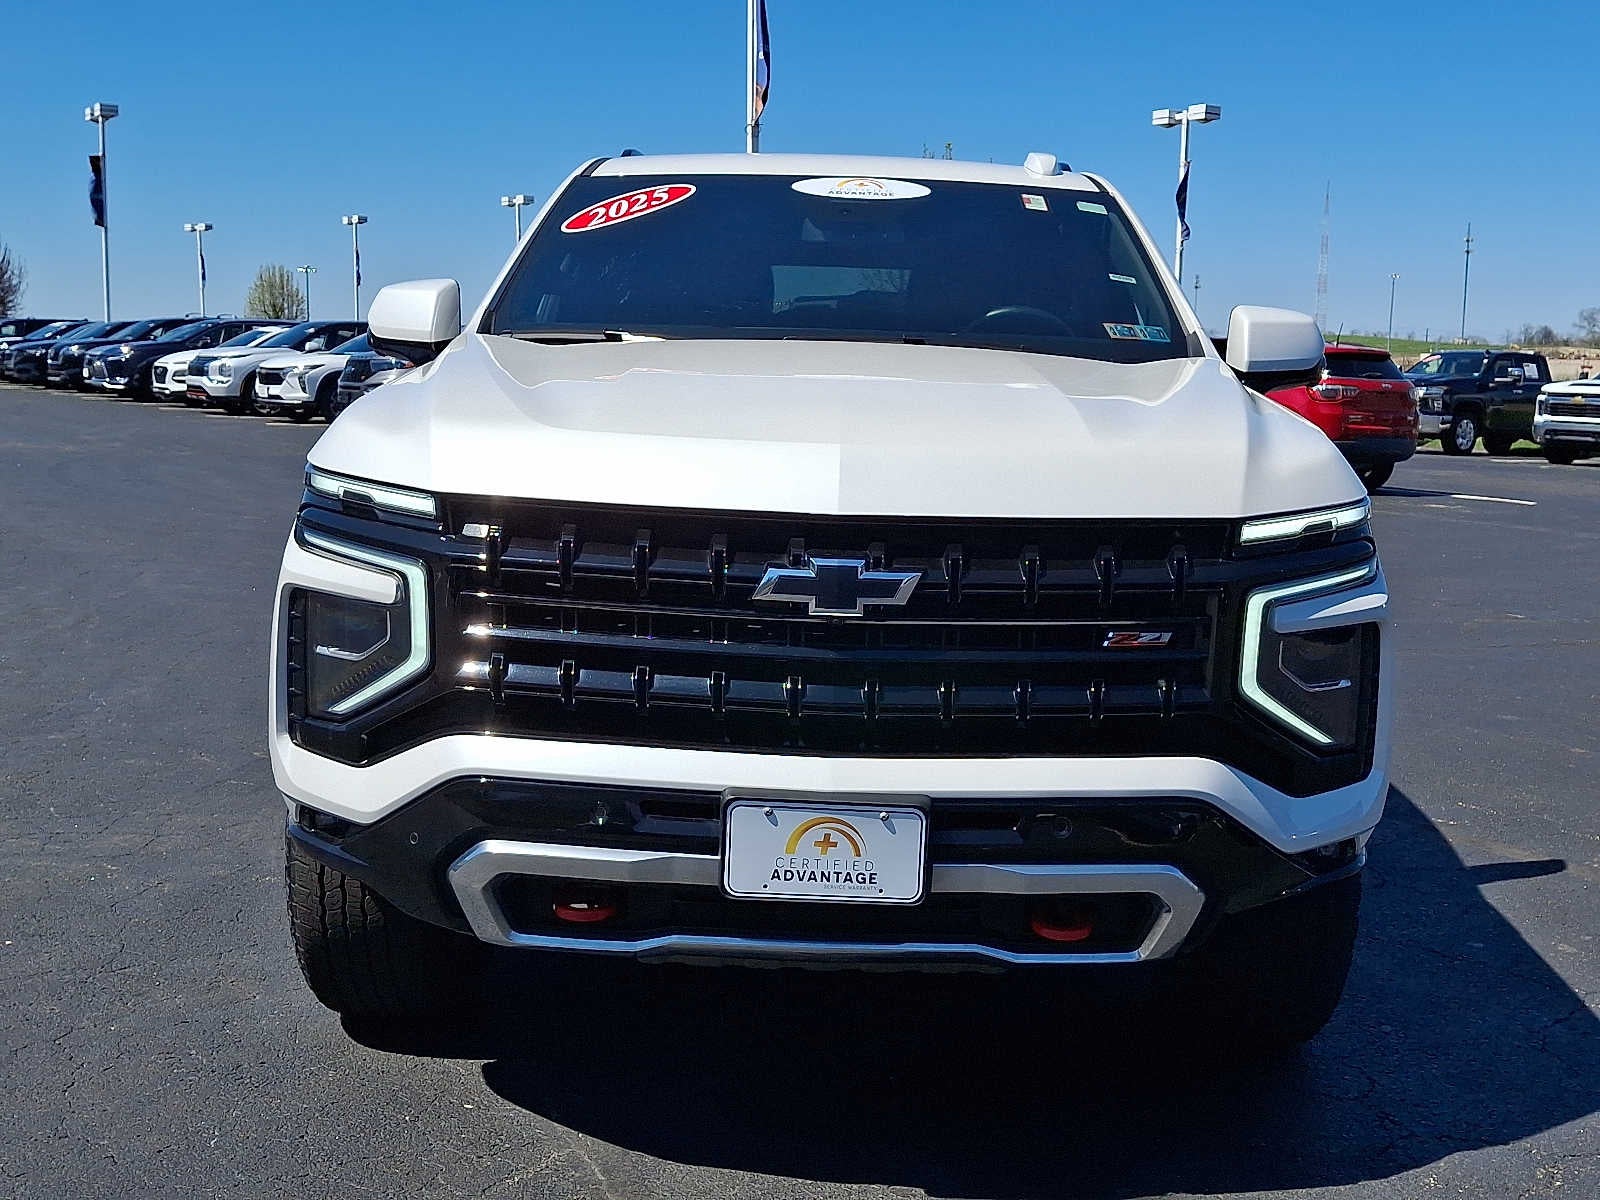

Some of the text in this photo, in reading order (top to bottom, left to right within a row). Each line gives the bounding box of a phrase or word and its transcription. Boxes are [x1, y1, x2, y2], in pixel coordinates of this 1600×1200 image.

[587, 187, 669, 227] 2025
[775, 857, 874, 871] CERTIFIED
[770, 868, 878, 885] ADVANTAGE
